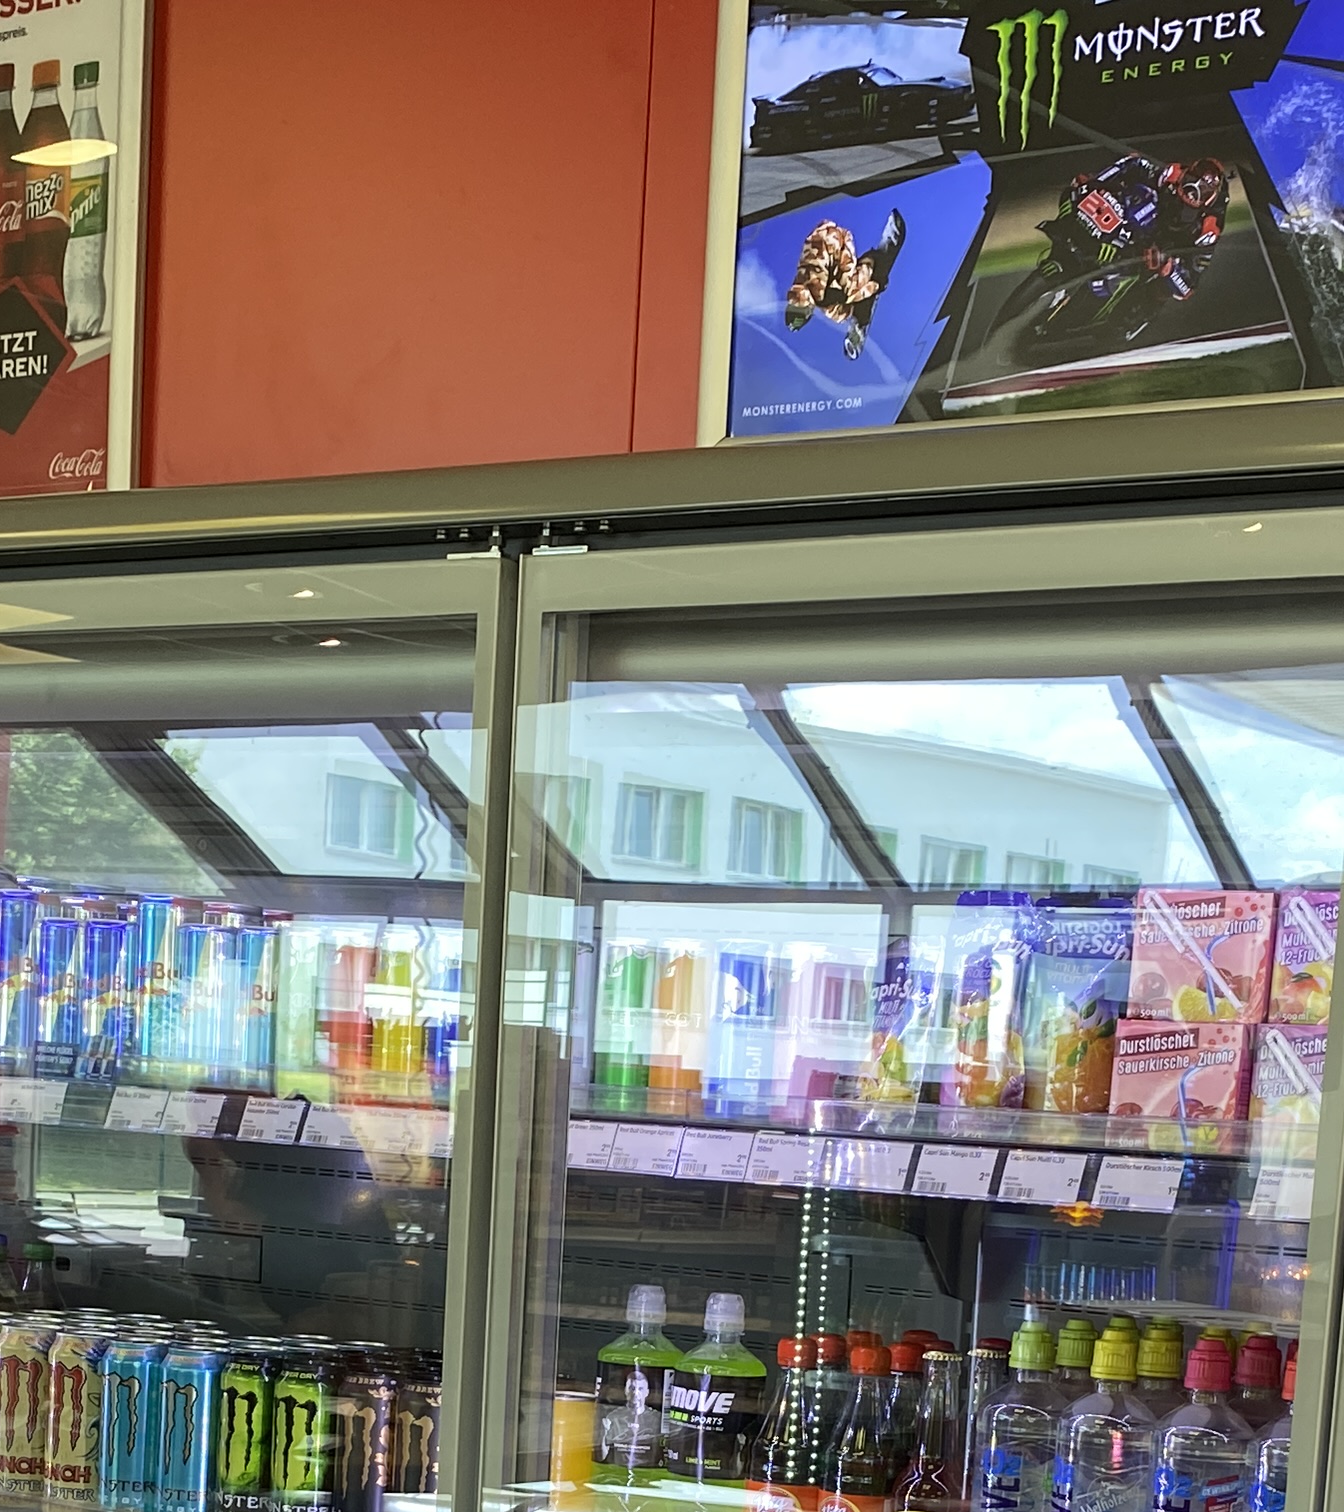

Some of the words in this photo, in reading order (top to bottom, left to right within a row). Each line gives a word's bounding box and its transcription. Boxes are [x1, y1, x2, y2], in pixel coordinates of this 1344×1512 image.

[1101, 51, 1235, 84] ENERGY
[1120, 1034, 1196, 1055] Durstlöscher
[1118, 1056, 1189, 1074] Sauerkirsche
[1198, 1049, 1235, 1067] Zitrone
